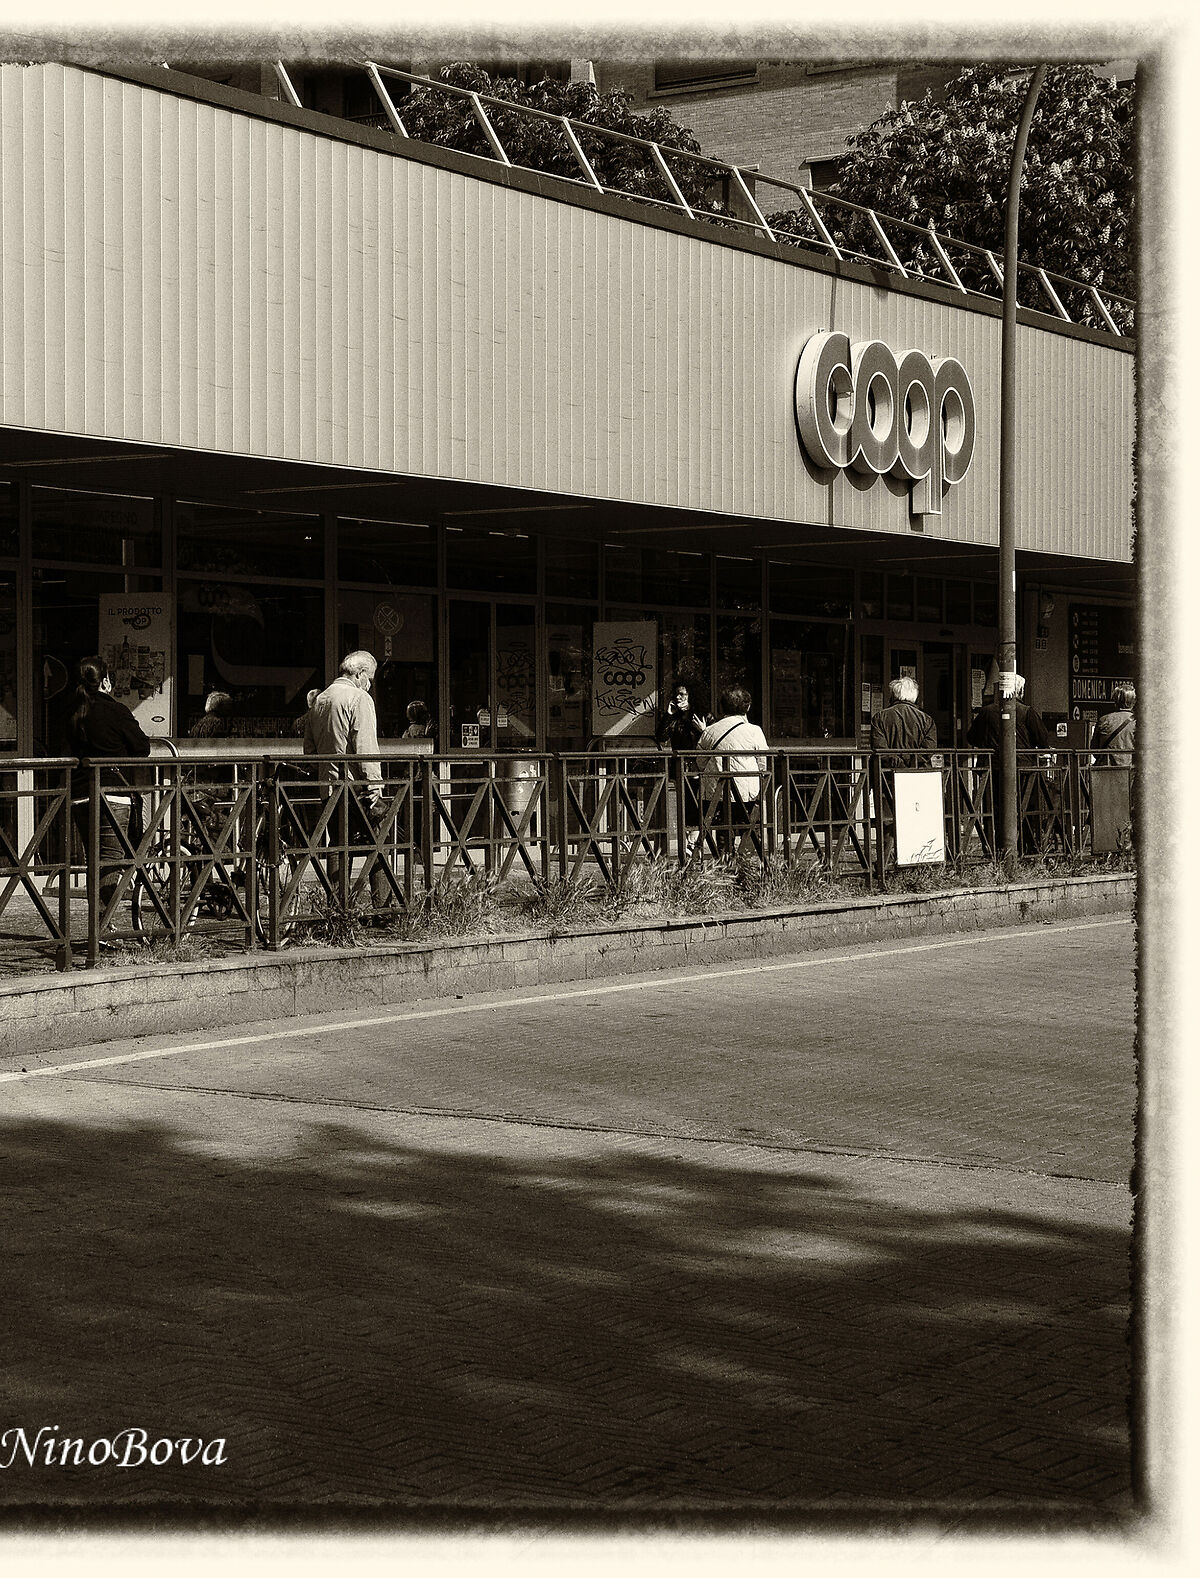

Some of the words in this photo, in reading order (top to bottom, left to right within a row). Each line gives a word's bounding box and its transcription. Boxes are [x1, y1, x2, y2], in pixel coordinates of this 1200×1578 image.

[797, 330, 976, 515] coop
[117, 607, 162, 615] PRODOTTO
[604, 671, 646, 689] coop
[1073, 679, 1106, 700] DOMENICA
